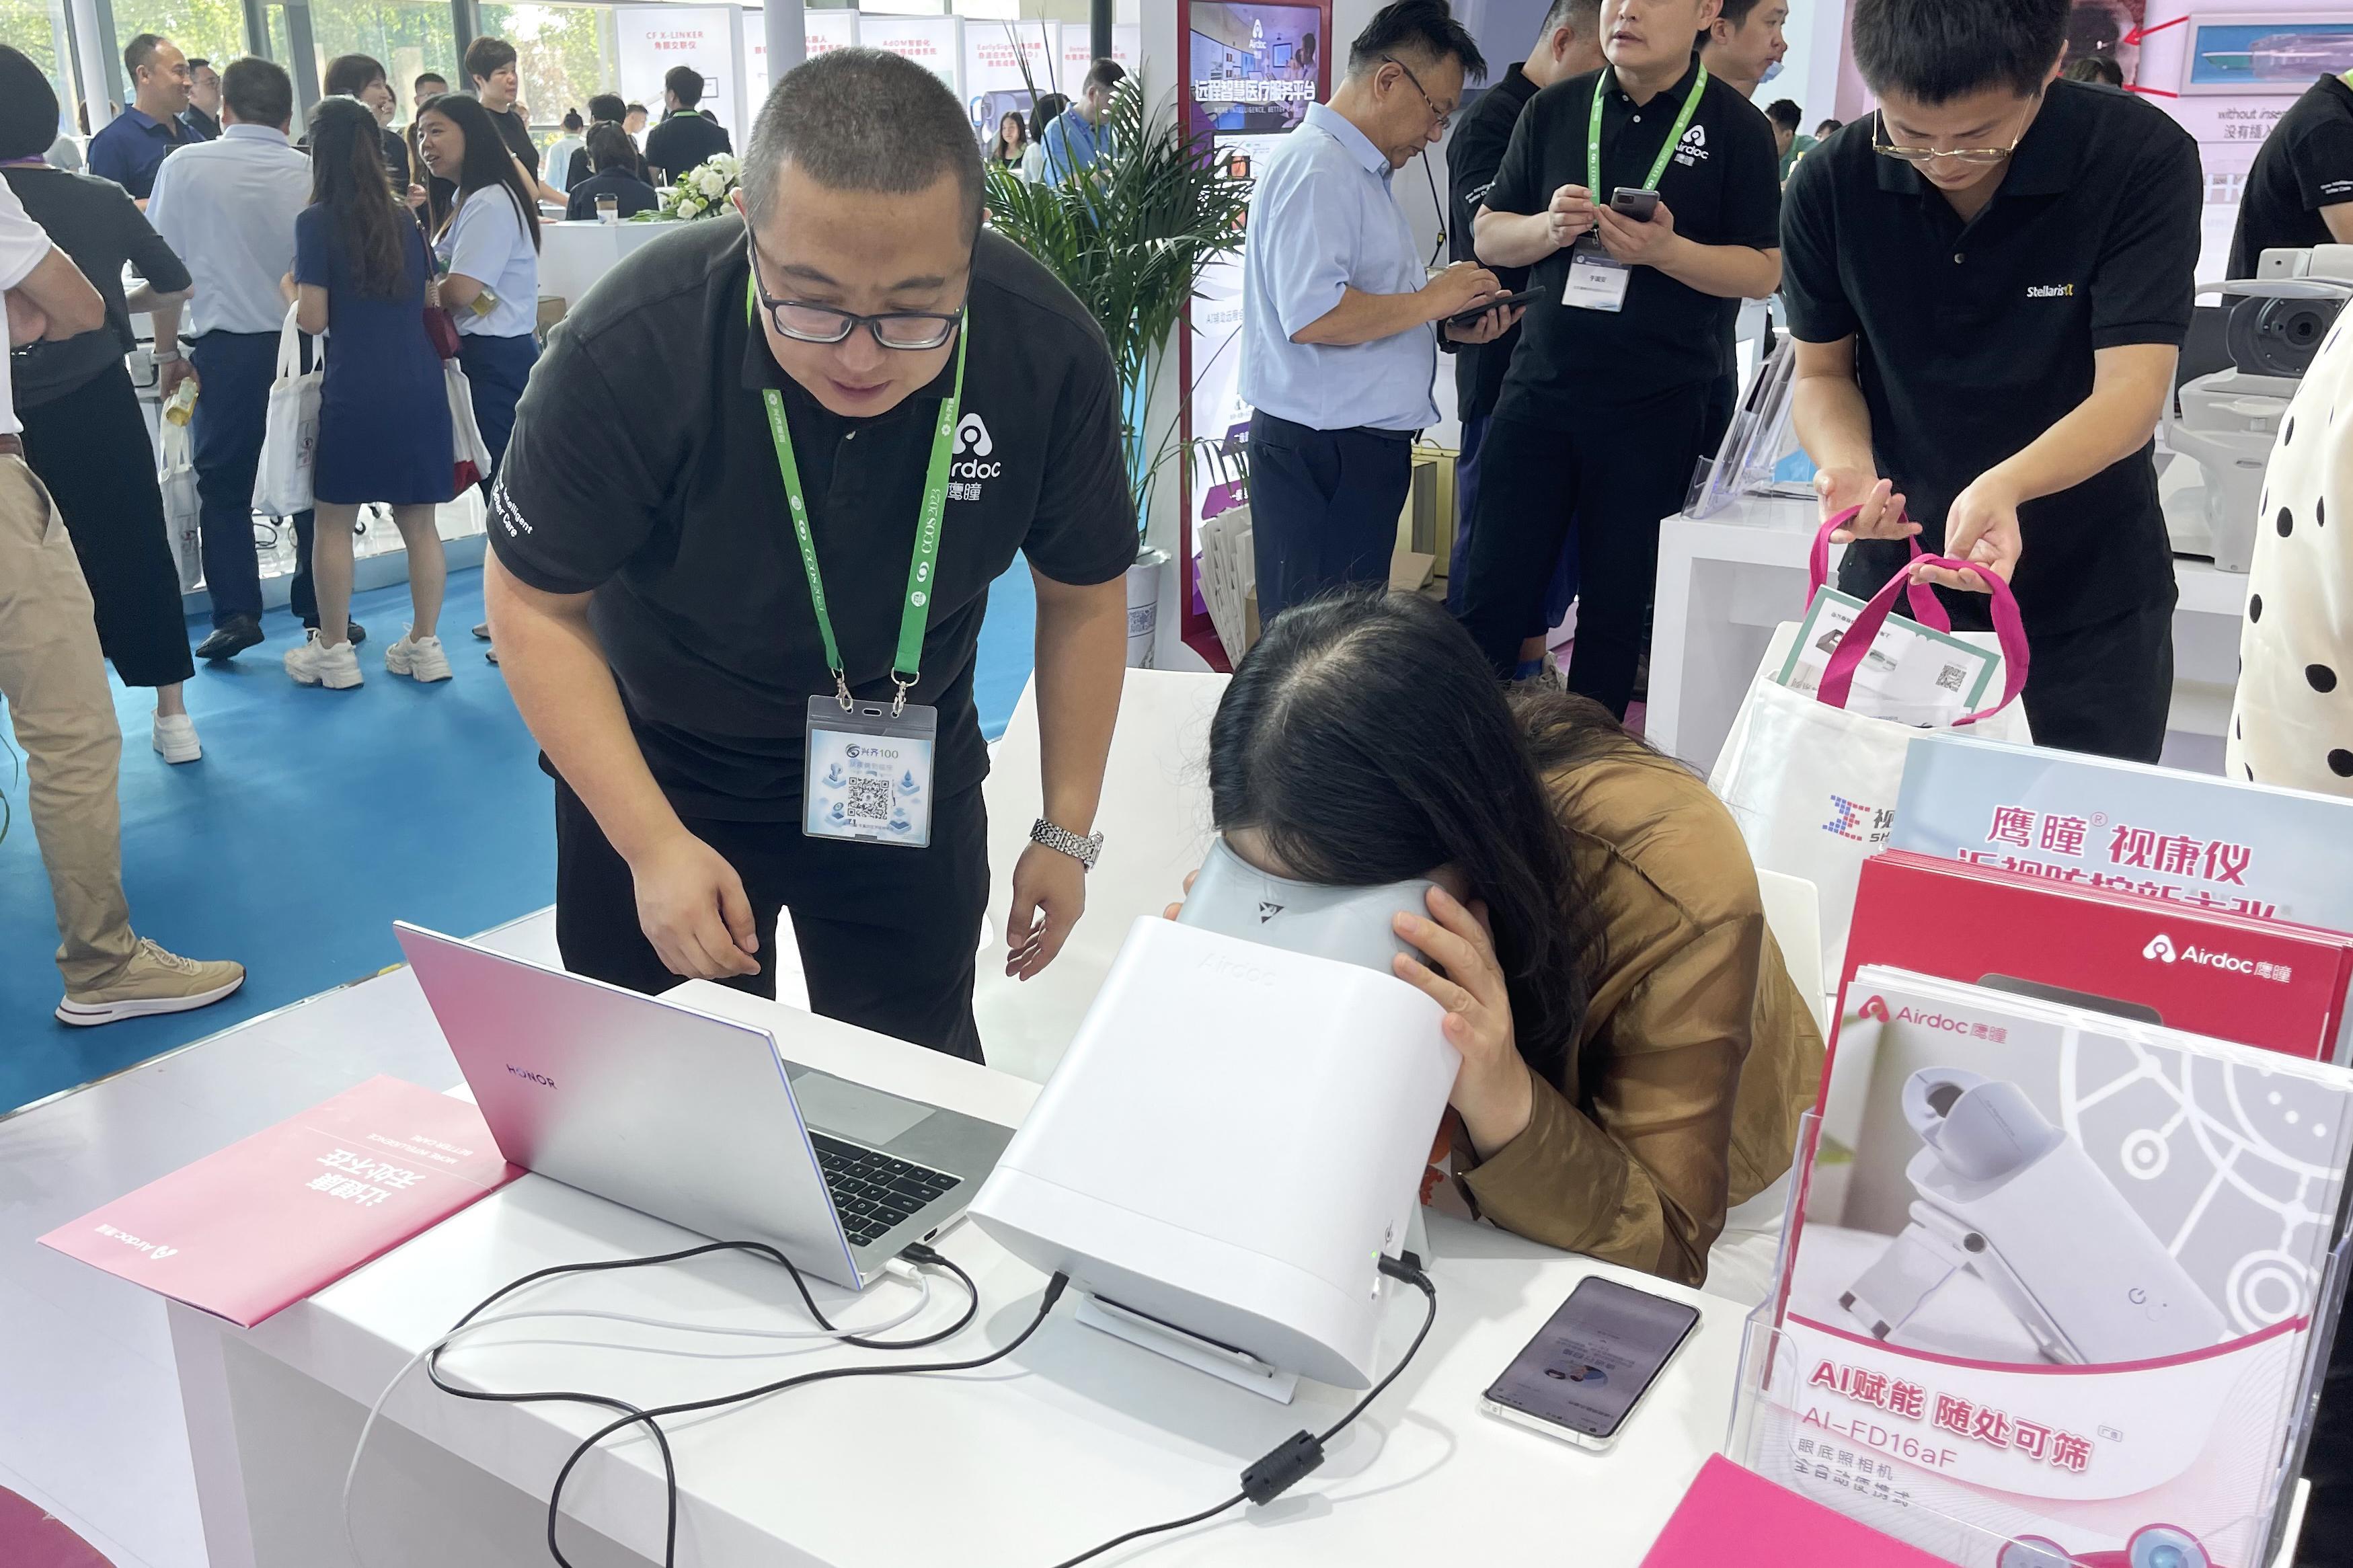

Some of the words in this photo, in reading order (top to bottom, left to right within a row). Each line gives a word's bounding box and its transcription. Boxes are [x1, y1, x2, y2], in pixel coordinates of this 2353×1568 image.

[1194, 79, 1316, 102] 远程智慧医疗服务平台
[2218, 107, 2258, 120] without
[950, 458, 1001, 479] rdoc
[2108, 824, 2253, 887] 视康仪
[2180, 945, 2253, 974] Airdoc
[1896, 1007, 1969, 1034] Airdoc
[506, 1063, 558, 1090] HONOR
[365, 1132, 431, 1157] INTELLIGENCE
[435, 1141, 474, 1157] BETTER
[315, 1148, 426, 1189] 无处不在
[305, 1172, 392, 1207] 让健康
[1810, 1360, 1926, 1419] AI赋能
[1933, 1394, 2093, 1471] 随处可筛
[1802, 1407, 1958, 1468] AI-FD16aF
[1798, 1438, 1894, 1481] 眼底照相机
